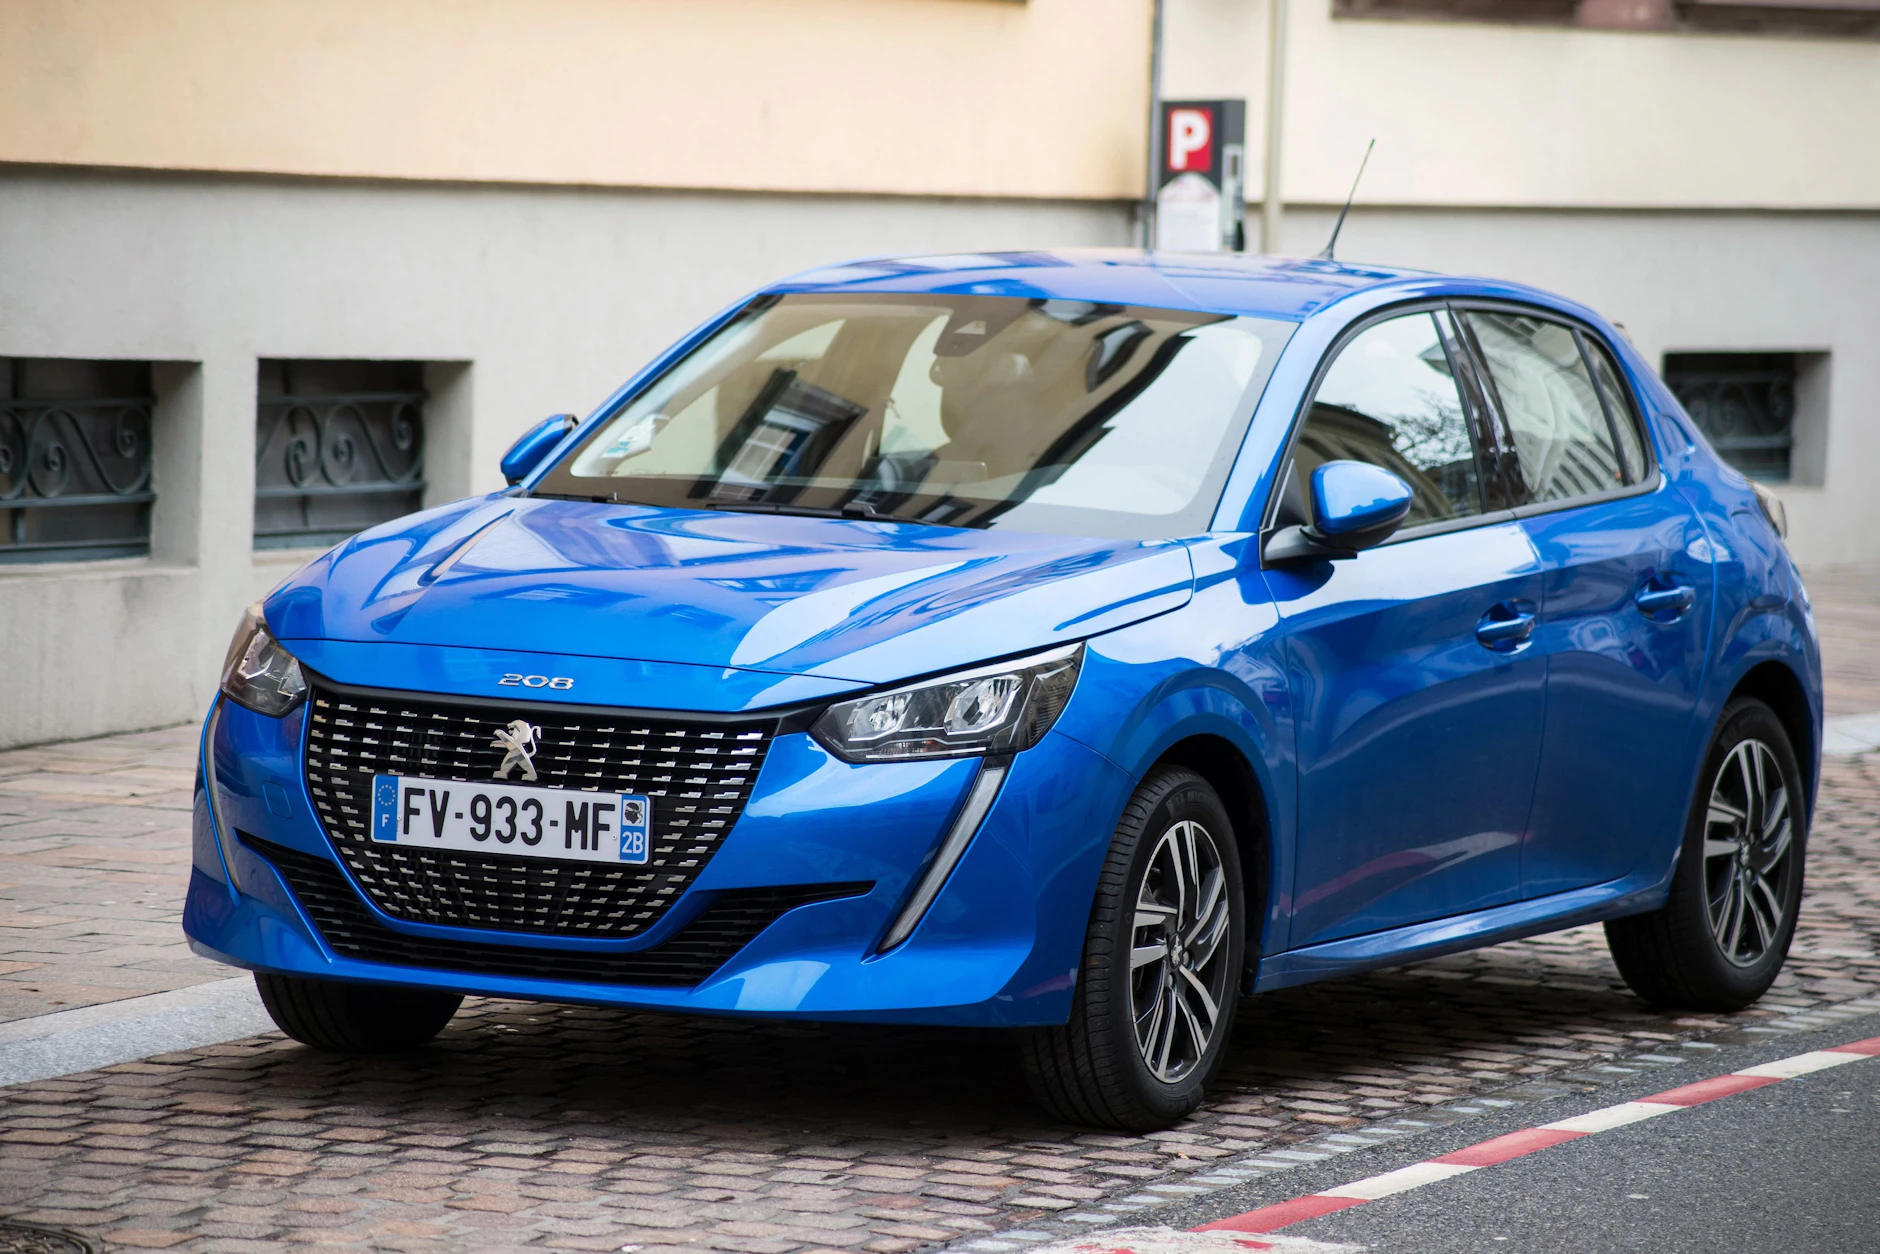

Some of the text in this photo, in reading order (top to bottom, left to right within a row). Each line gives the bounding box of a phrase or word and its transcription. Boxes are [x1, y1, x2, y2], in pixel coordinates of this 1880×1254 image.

[1170, 109, 1211, 170] P
[498, 673, 574, 689] 208
[381, 814, 389, 828] F
[402, 787, 616, 851] FV-933-MF
[621, 832, 644, 854] 2B
